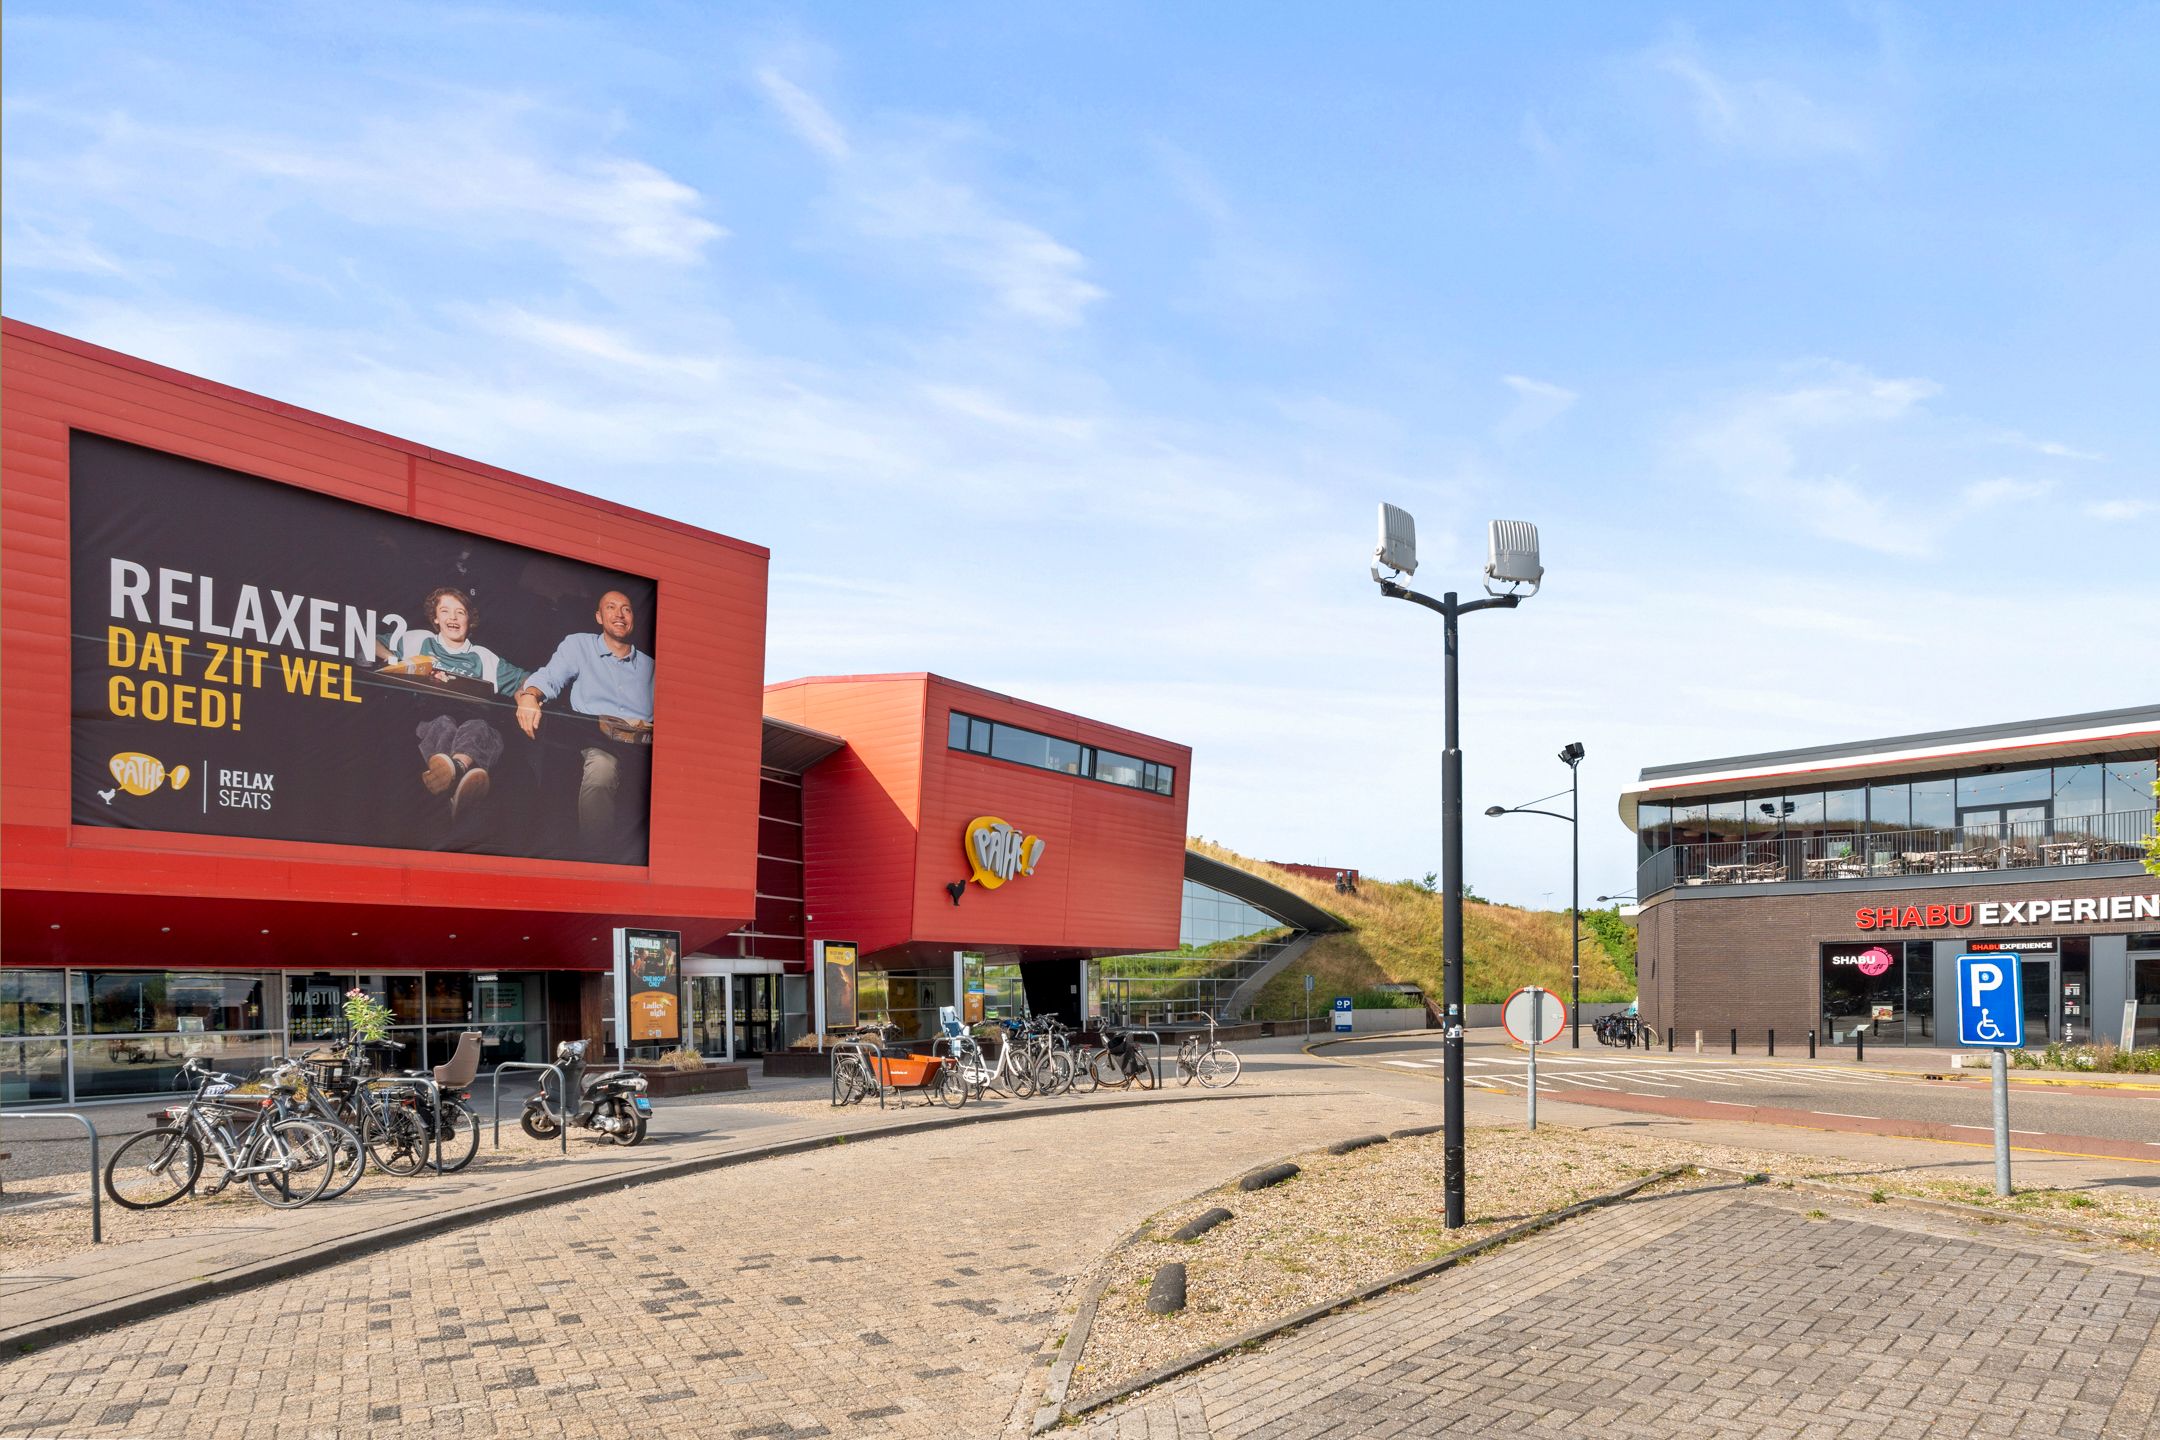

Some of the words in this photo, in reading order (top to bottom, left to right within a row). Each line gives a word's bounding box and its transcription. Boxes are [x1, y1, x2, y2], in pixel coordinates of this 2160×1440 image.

[110, 557, 408, 665] RELAXEN?
[108, 625, 190, 676] DAT
[204, 642, 268, 689] ZIT
[280, 654, 363, 704] WEL
[108, 675, 242, 732] GOED!
[218, 789, 272, 810] SEATS
[219, 769, 274, 791] RELAX
[1855, 903, 1972, 928] SHABU
[1979, 894, 2160, 925] EXPERIEN
[1832, 955, 1876, 965] SHABU
[1970, 963, 2003, 1007] P
